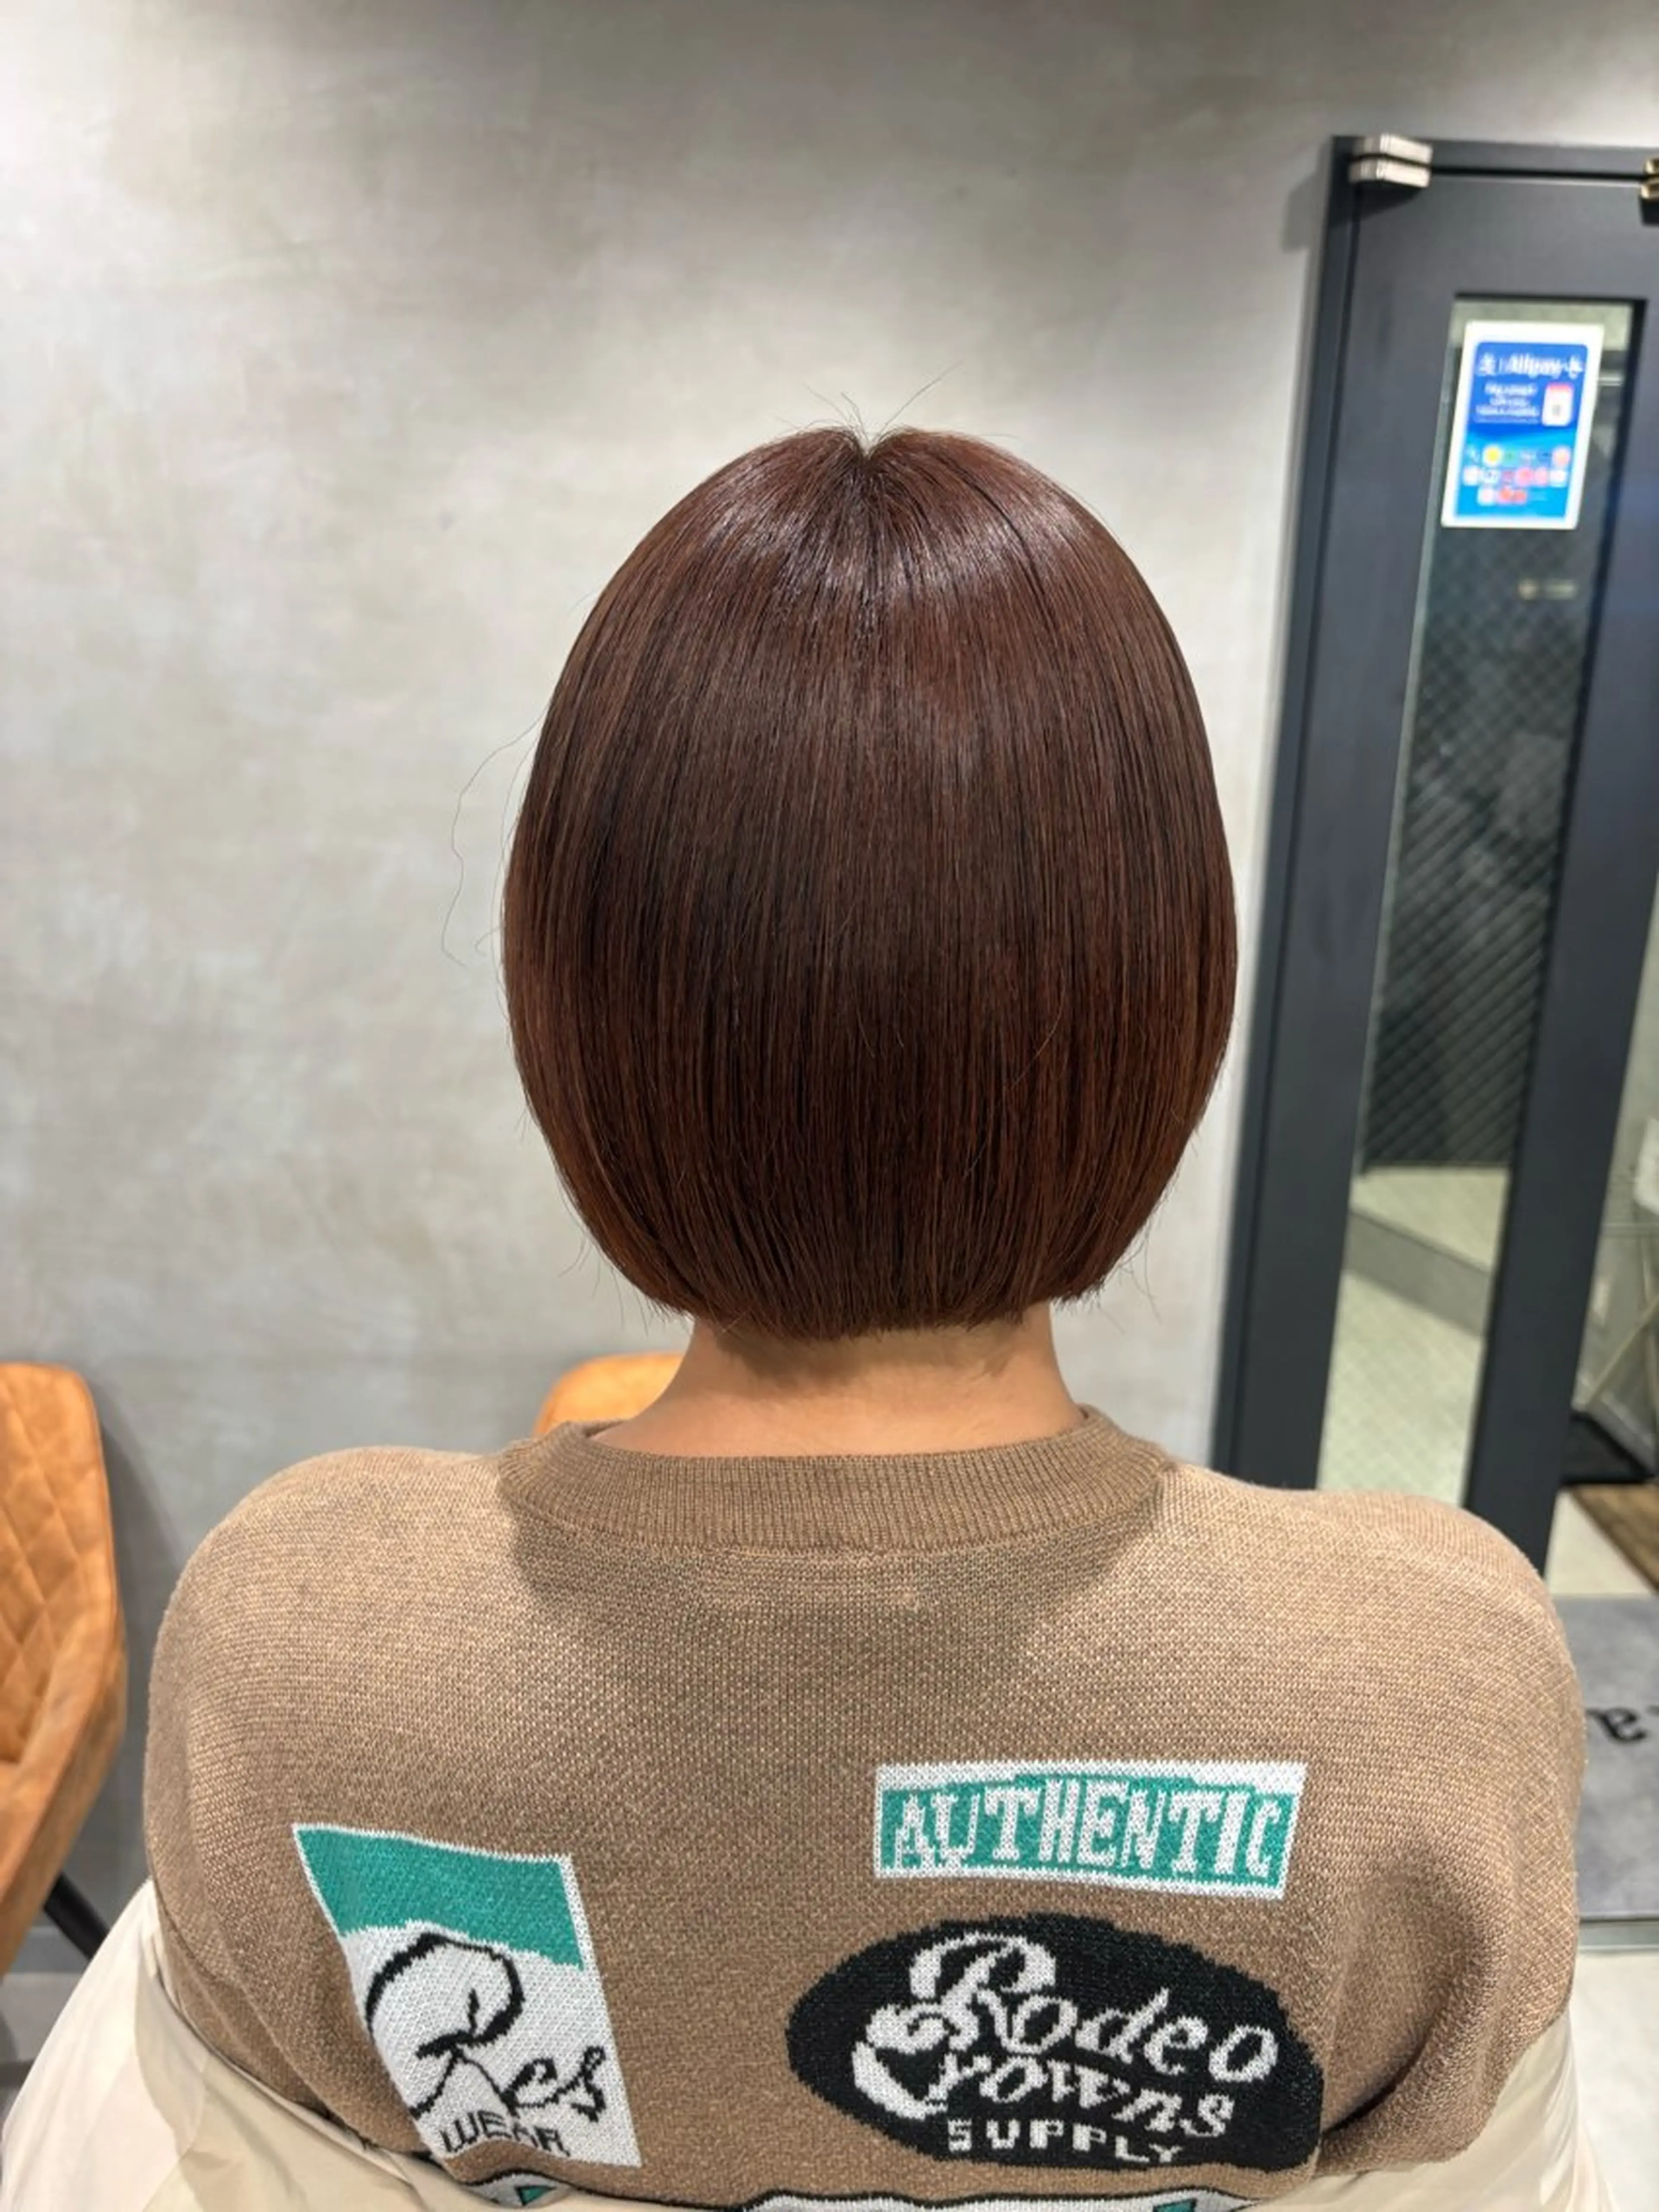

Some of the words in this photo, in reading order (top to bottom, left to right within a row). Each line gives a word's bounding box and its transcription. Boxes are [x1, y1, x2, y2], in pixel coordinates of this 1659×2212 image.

[894, 1777, 1280, 1877] AUTHENTIC
[865, 1932, 1278, 2082] Rodeo
[439, 2110, 570, 2157] WEAR
[852, 2042, 1234, 2137] Crowns
[948, 2119, 1181, 2163] SUPPLY
